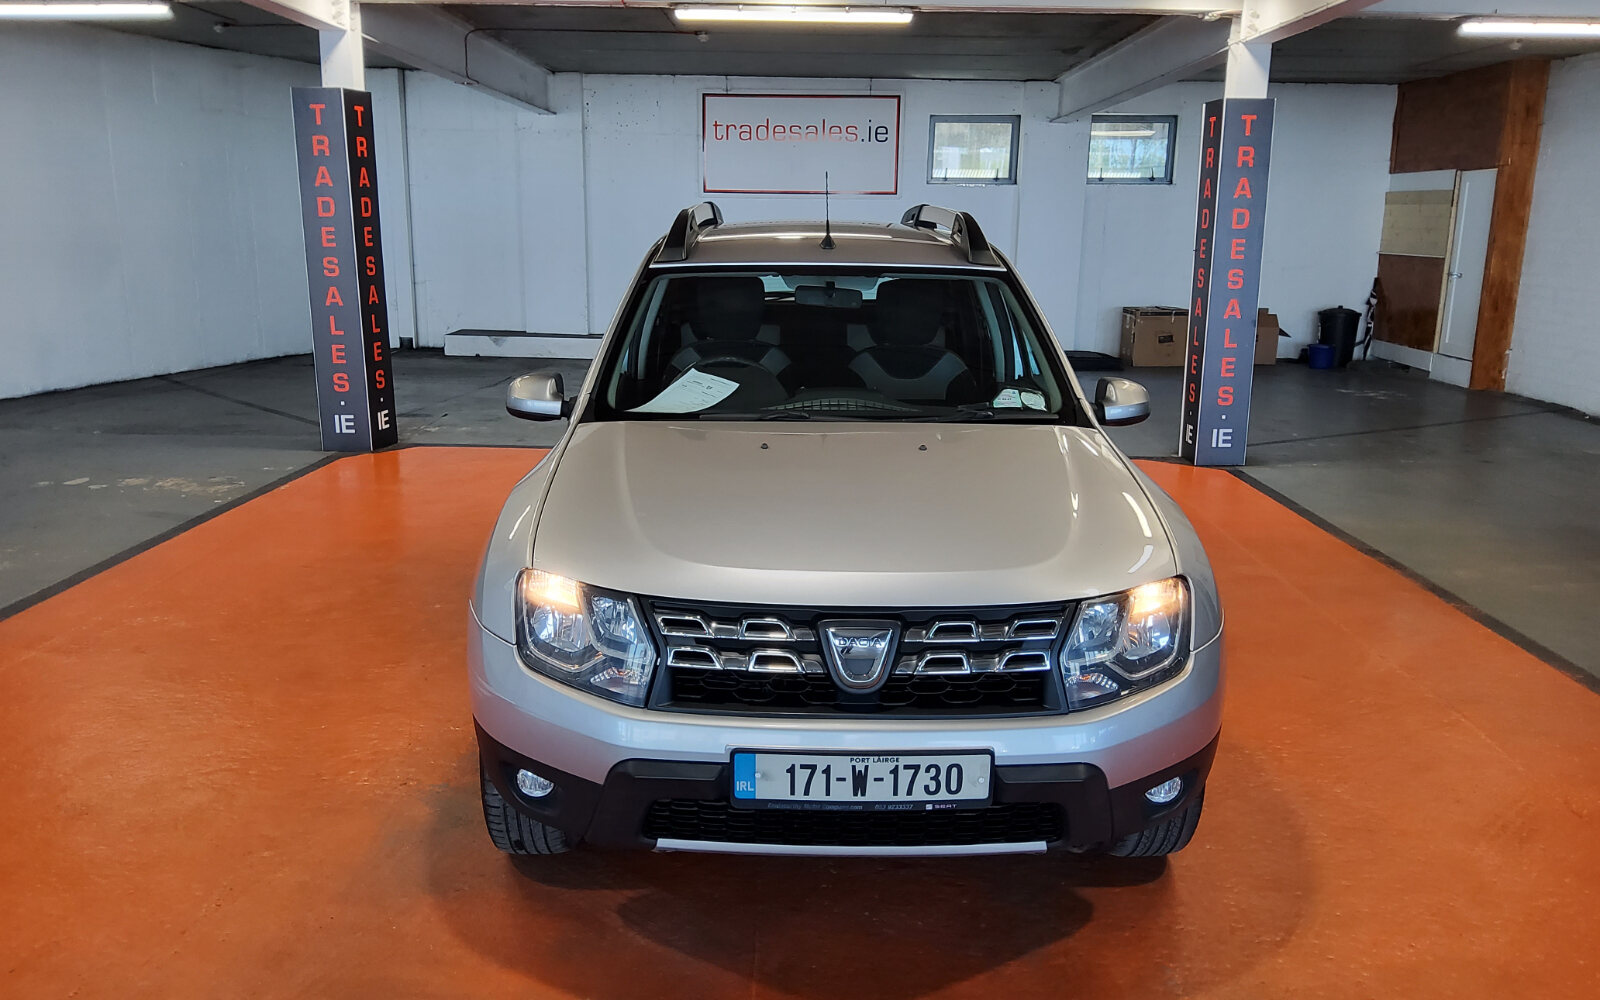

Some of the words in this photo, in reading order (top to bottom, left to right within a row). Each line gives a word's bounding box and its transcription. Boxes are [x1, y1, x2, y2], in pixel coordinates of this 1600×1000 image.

[712, 118, 889, 142] tradesales.ie
[838, 637, 882, 647] DACIA
[736, 780, 755, 792] IRL
[785, 763, 964, 797] 171-W-1730
